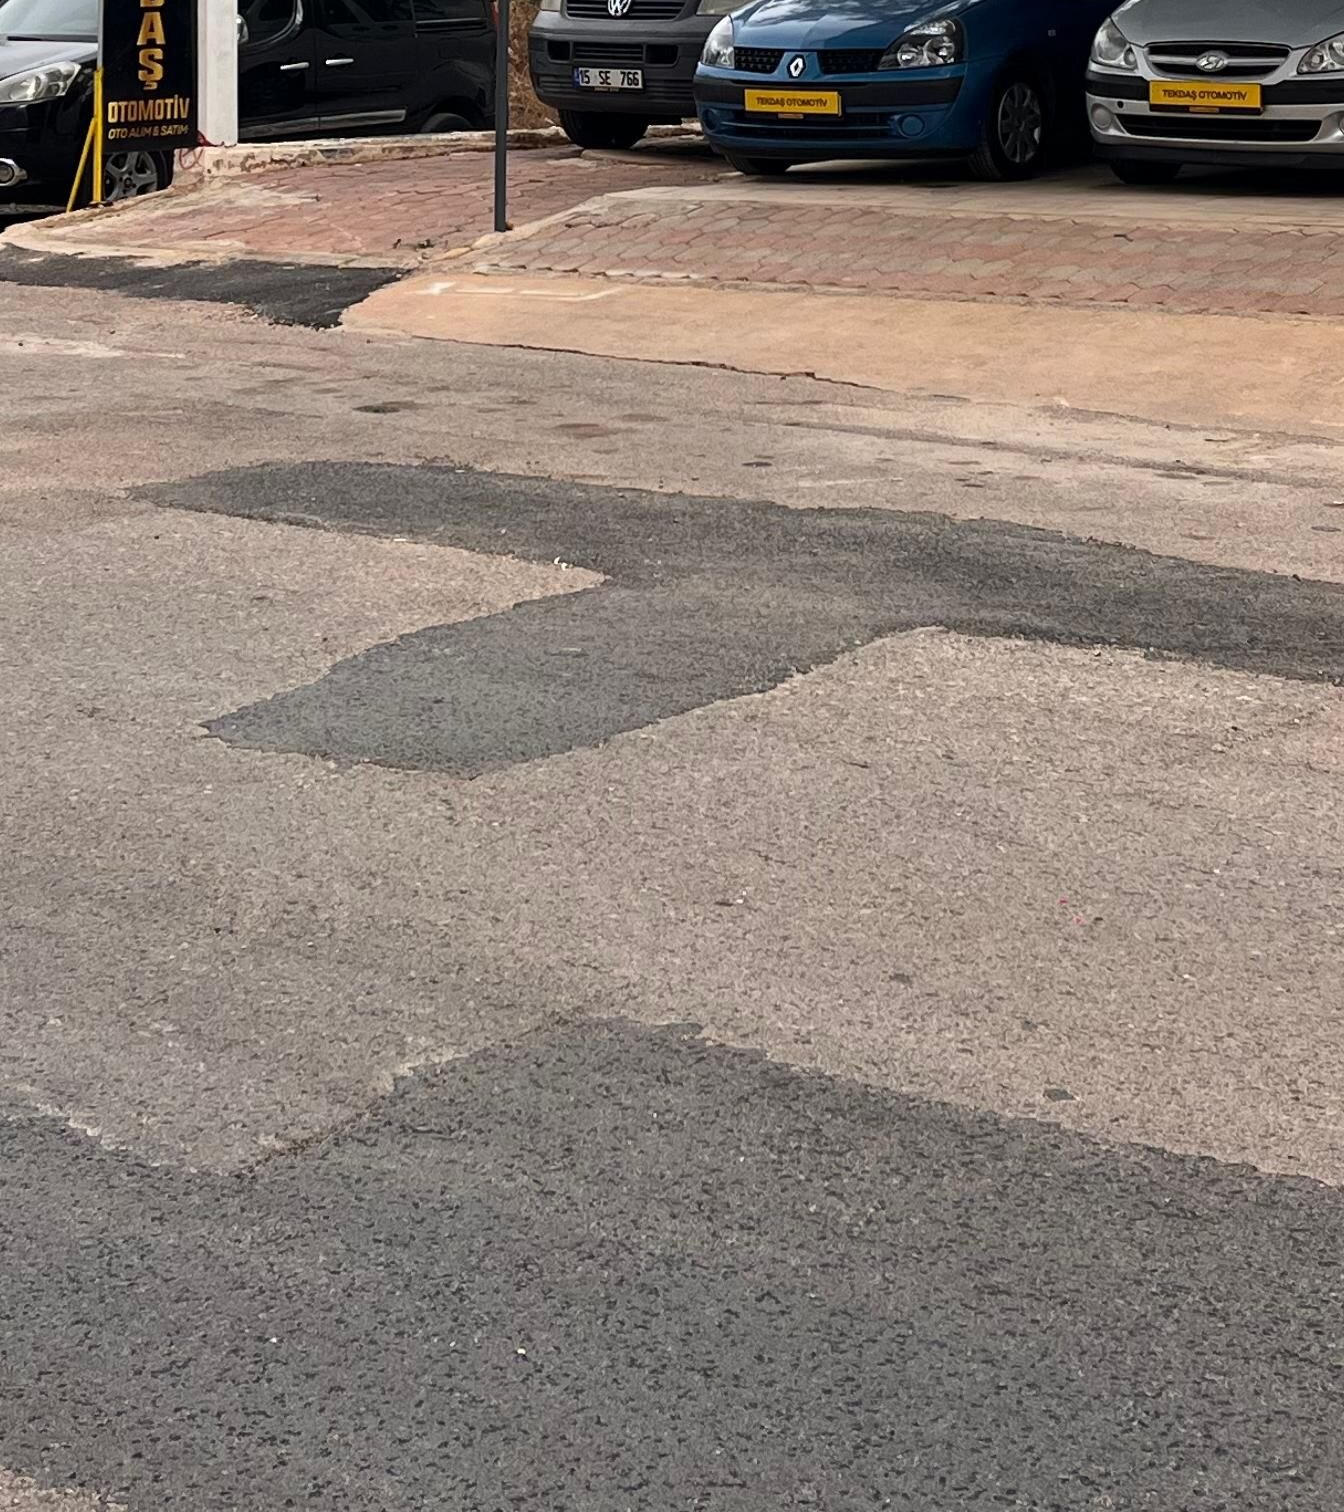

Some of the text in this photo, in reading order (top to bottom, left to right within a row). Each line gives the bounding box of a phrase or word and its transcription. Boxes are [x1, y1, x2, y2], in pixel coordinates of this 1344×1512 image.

[579, 70, 591, 84] 15
[619, 71, 640, 86] 766
[107, 94, 190, 124] OTOMOTİV
[108, 128, 129, 141] OTO
